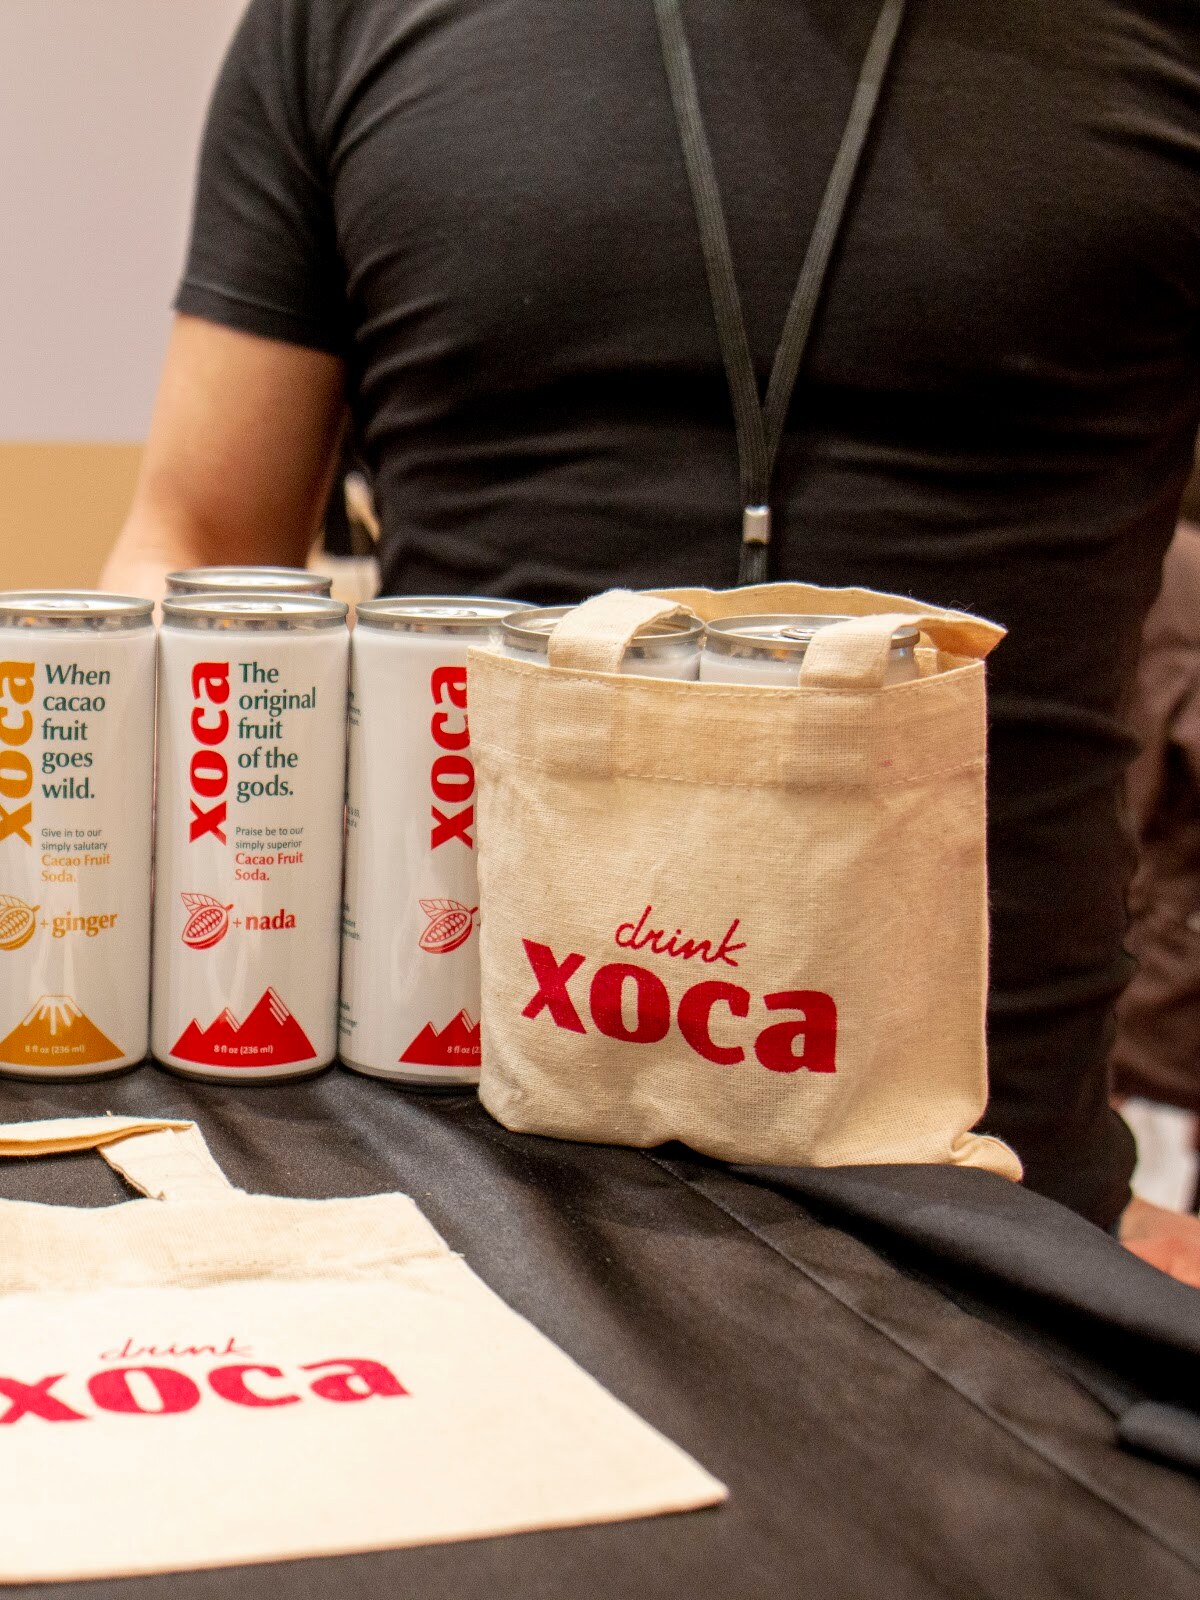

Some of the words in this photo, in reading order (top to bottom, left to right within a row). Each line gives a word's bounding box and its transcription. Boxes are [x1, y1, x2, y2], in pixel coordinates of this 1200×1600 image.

[44, 663, 111, 686] When
[238, 661, 279, 683] The
[43, 694, 106, 712] cacao
[238, 687, 316, 717] original
[42, 718, 88, 741] fruit
[238, 717, 283, 739] fruit
[42, 749, 93, 774] goes
[189, 661, 230, 846] xoca
[238, 746, 263, 768] of
[265, 747, 298, 768] the
[431, 666, 475, 850] xoca
[42, 777, 95, 799] wild.
[237, 776, 294, 803] gods.
[41, 828, 61, 838] Give
[64, 828, 73, 837] in
[75, 829, 84, 837] to
[87, 829, 102, 837] our
[235, 827, 262, 836] Praise
[265, 827, 276, 836] be
[278, 827, 288, 836] to
[289, 827, 304, 835] our
[41, 842, 71, 852] simply
[73, 841, 108, 851] salutary
[235, 840, 264, 851] simply
[267, 840, 302, 850] superior
[41, 854, 81, 866] Cacao
[84, 852, 111, 865] Fruit
[235, 852, 274, 865] Cacao
[277, 851, 304, 864] Fruit
[41, 870, 76, 882] Soda.
[235, 868, 270, 880] Soda.
[52, 911, 118, 938] ginger
[245, 908, 296, 930] nada
[614, 905, 746, 967] drink
[520, 938, 838, 1073] xoca
[24, 1045, 30, 1053] 8
[31, 1045, 38, 1053] fl
[51, 1046, 70, 1055] (236
[214, 1045, 220, 1053] 8
[221, 1045, 227, 1053] fl
[240, 1045, 258, 1055] (236
[260, 1045, 273, 1053] ml)
[446, 1046, 453, 1054] 8
[453, 1046, 460, 1054] fl
[99, 1337, 253, 1361] drink
